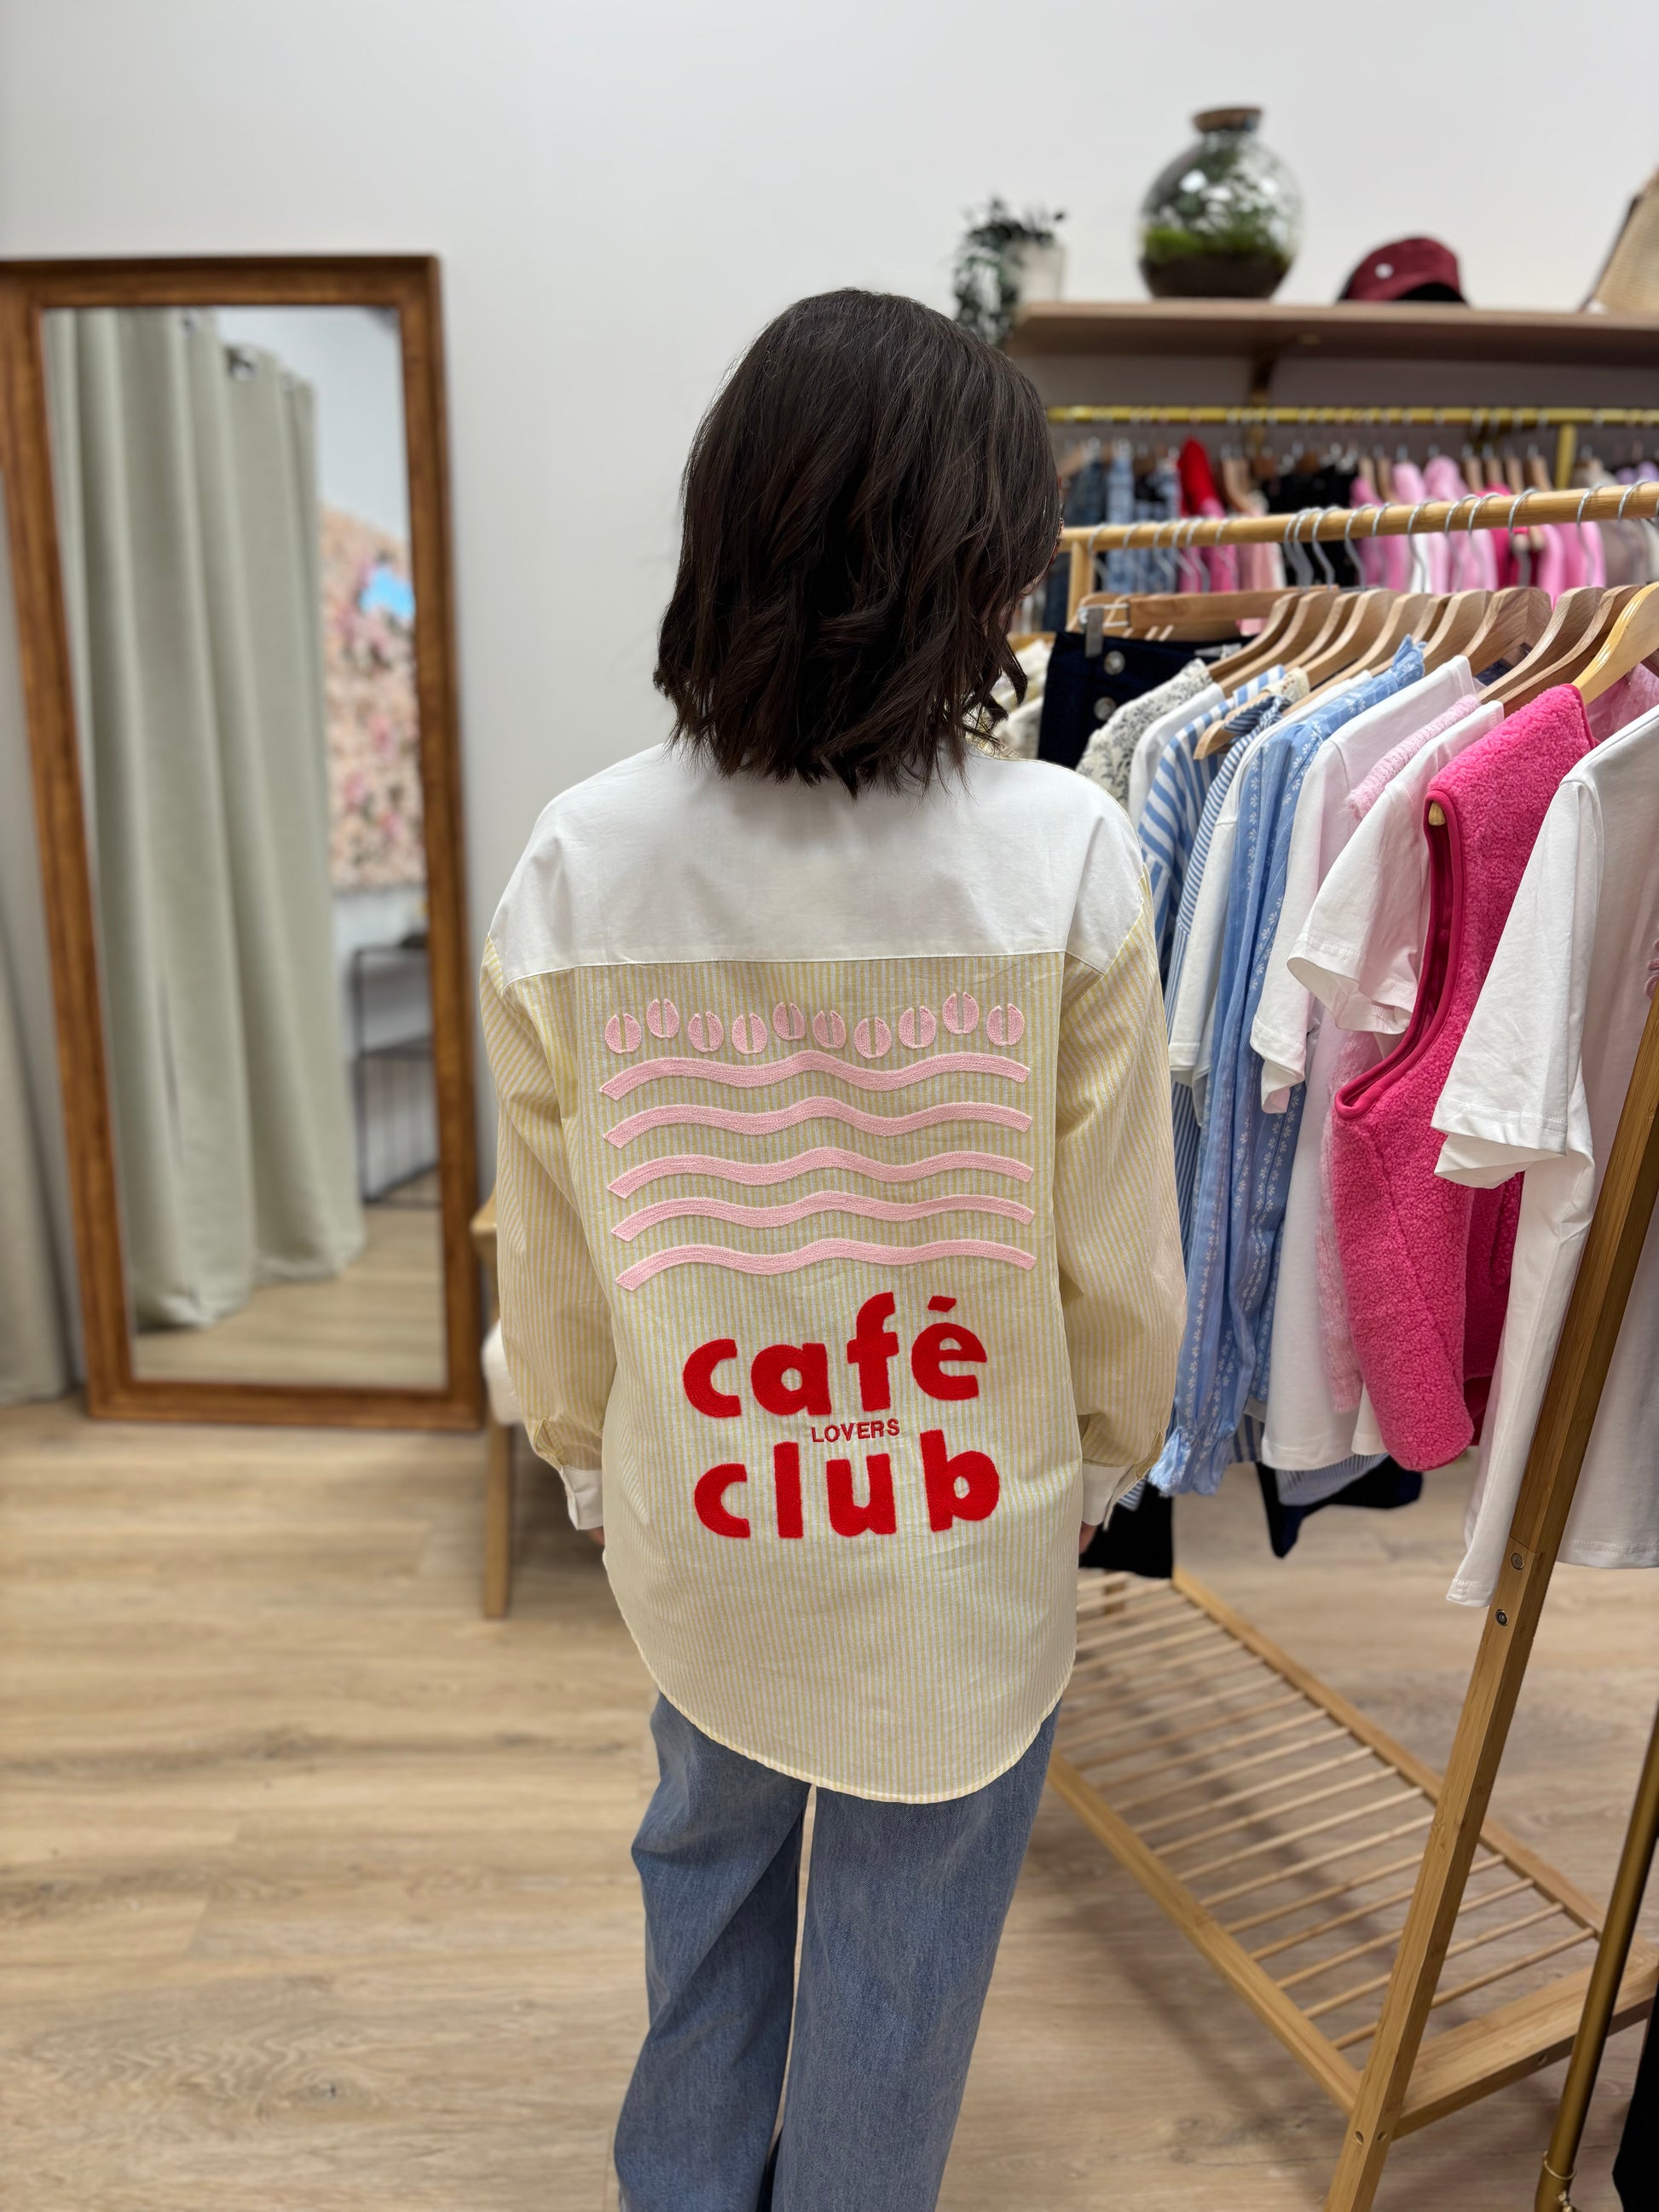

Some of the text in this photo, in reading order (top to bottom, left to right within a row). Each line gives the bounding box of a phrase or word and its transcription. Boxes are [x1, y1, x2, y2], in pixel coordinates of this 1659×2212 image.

[682, 1291, 988, 1418] café
[693, 1429, 1000, 1539] club
[811, 1418, 900, 1444] LOVERS
